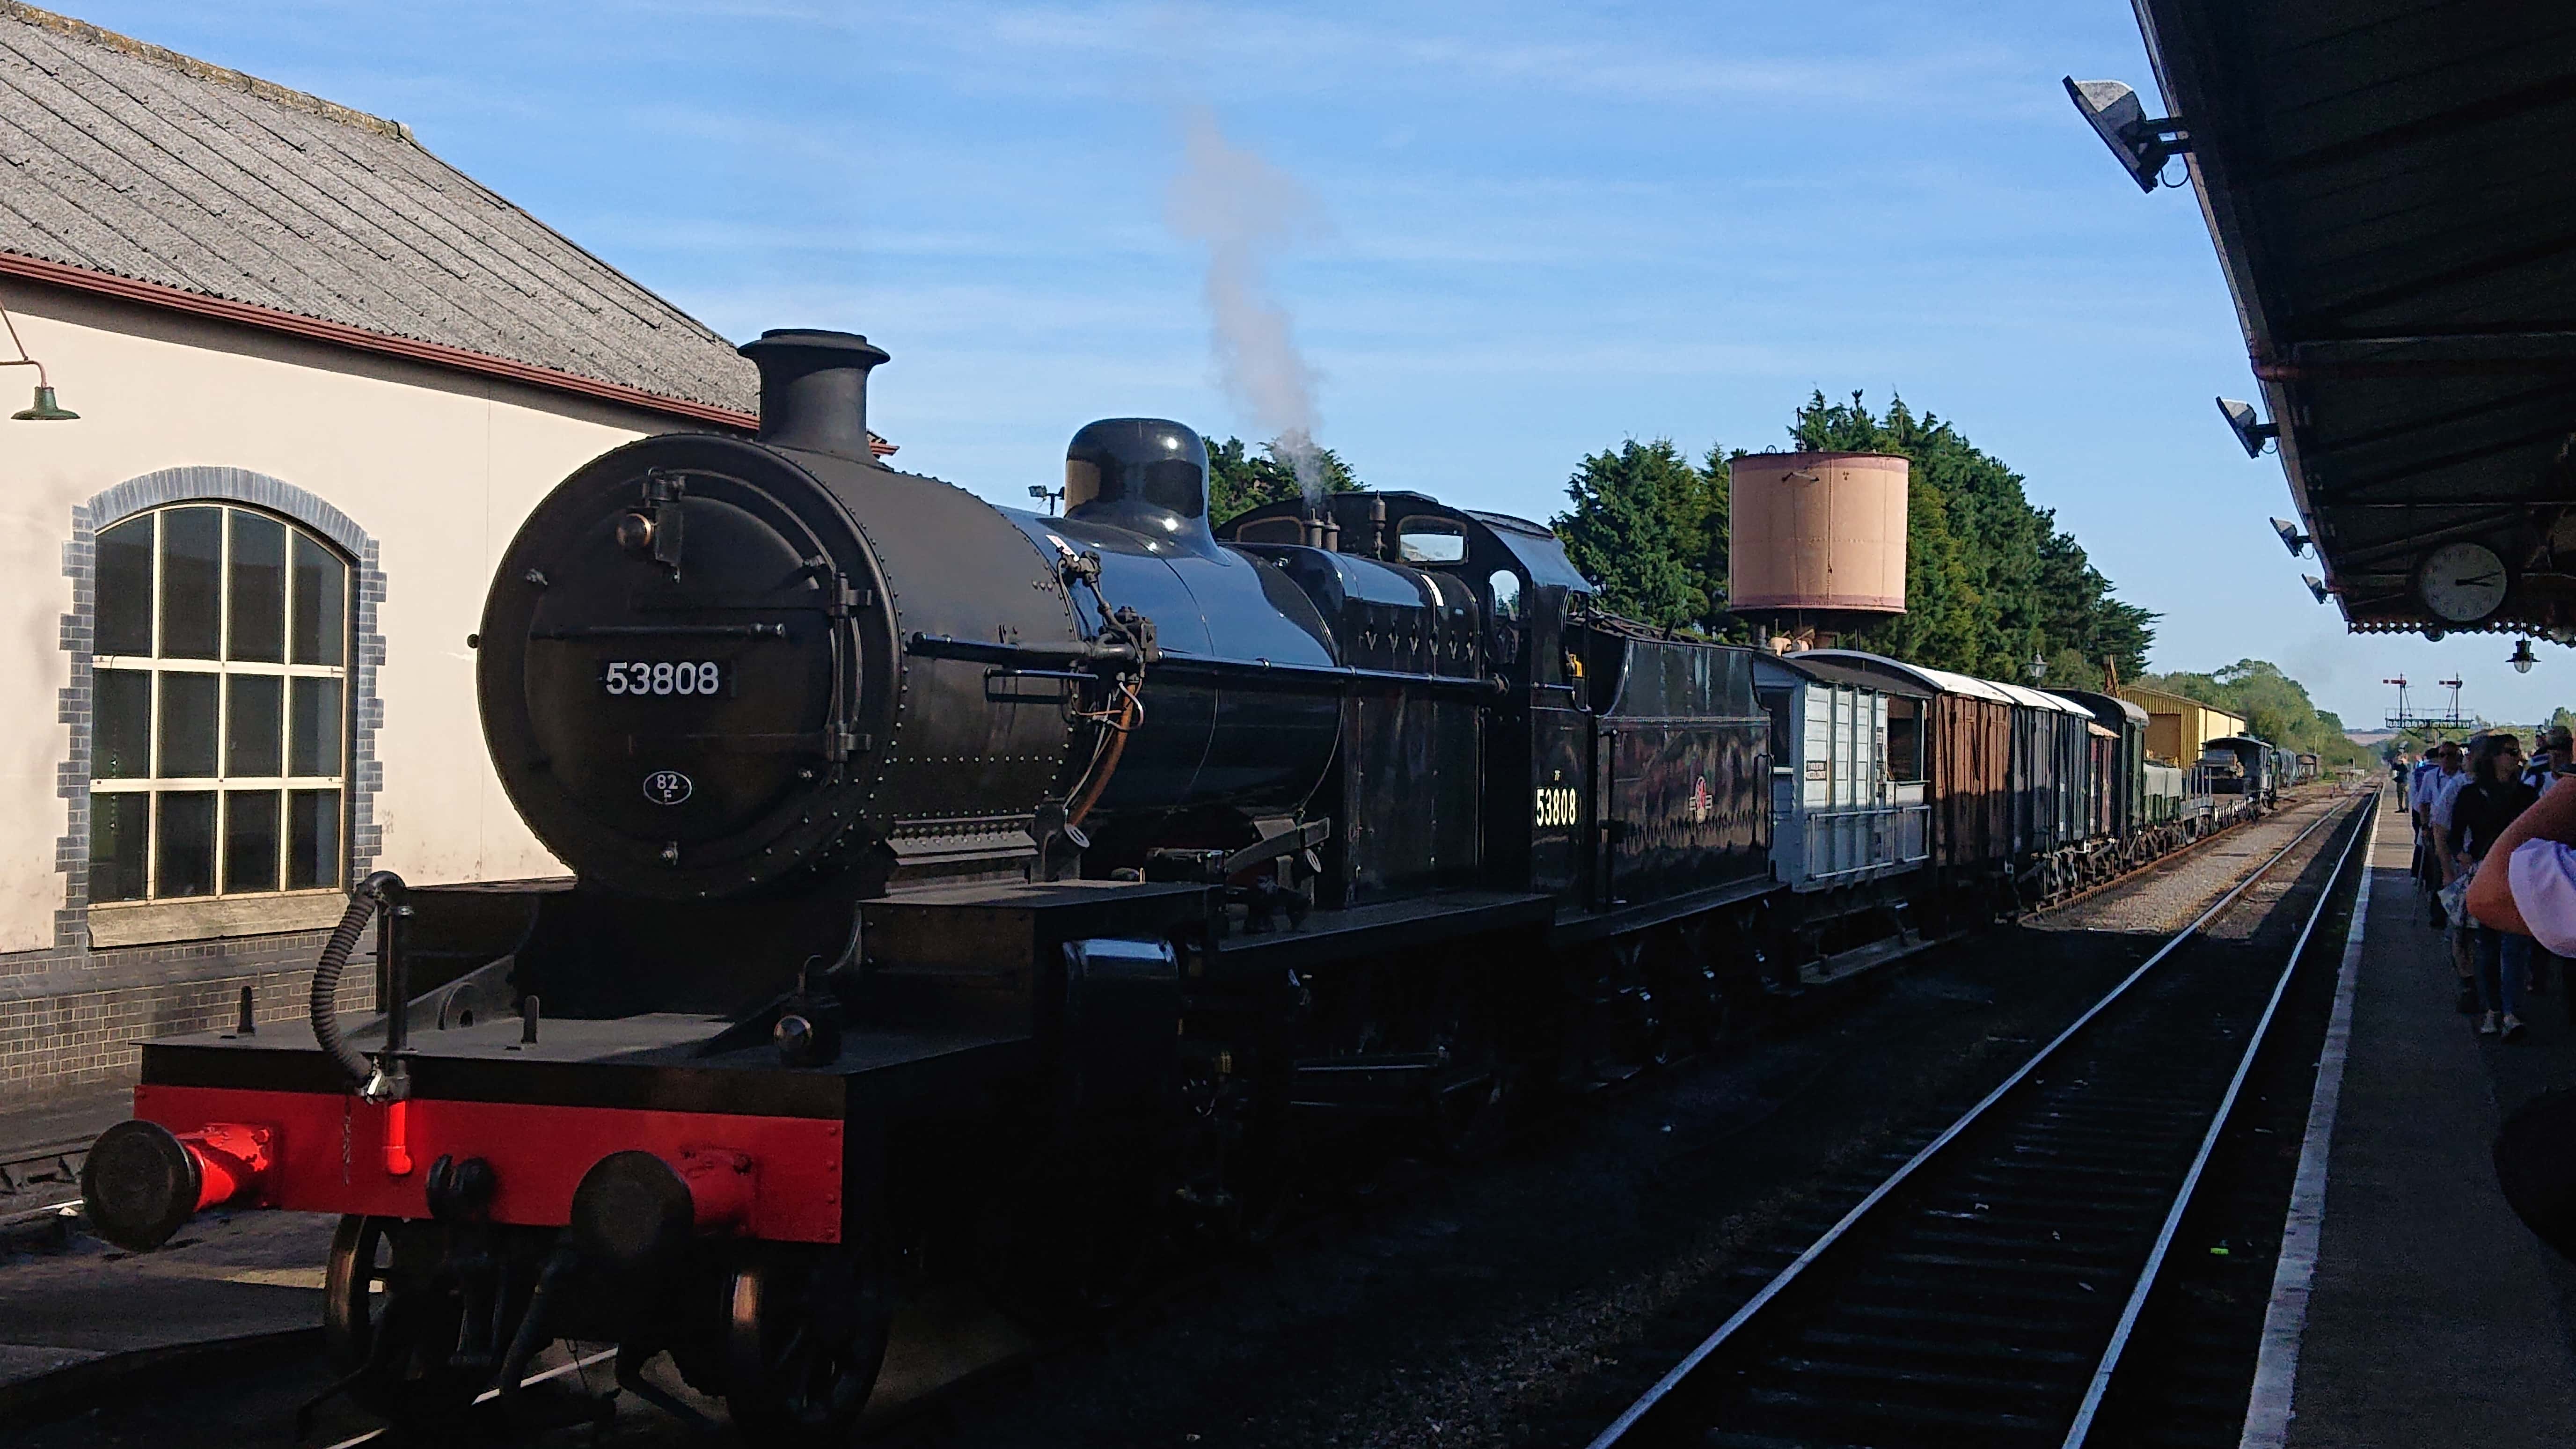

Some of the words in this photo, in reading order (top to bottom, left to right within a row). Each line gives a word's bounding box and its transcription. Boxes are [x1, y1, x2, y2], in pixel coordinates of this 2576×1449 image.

[606, 661, 719, 695] 53808
[657, 774, 678, 789] 82
[1536, 788, 1576, 826] 53808
